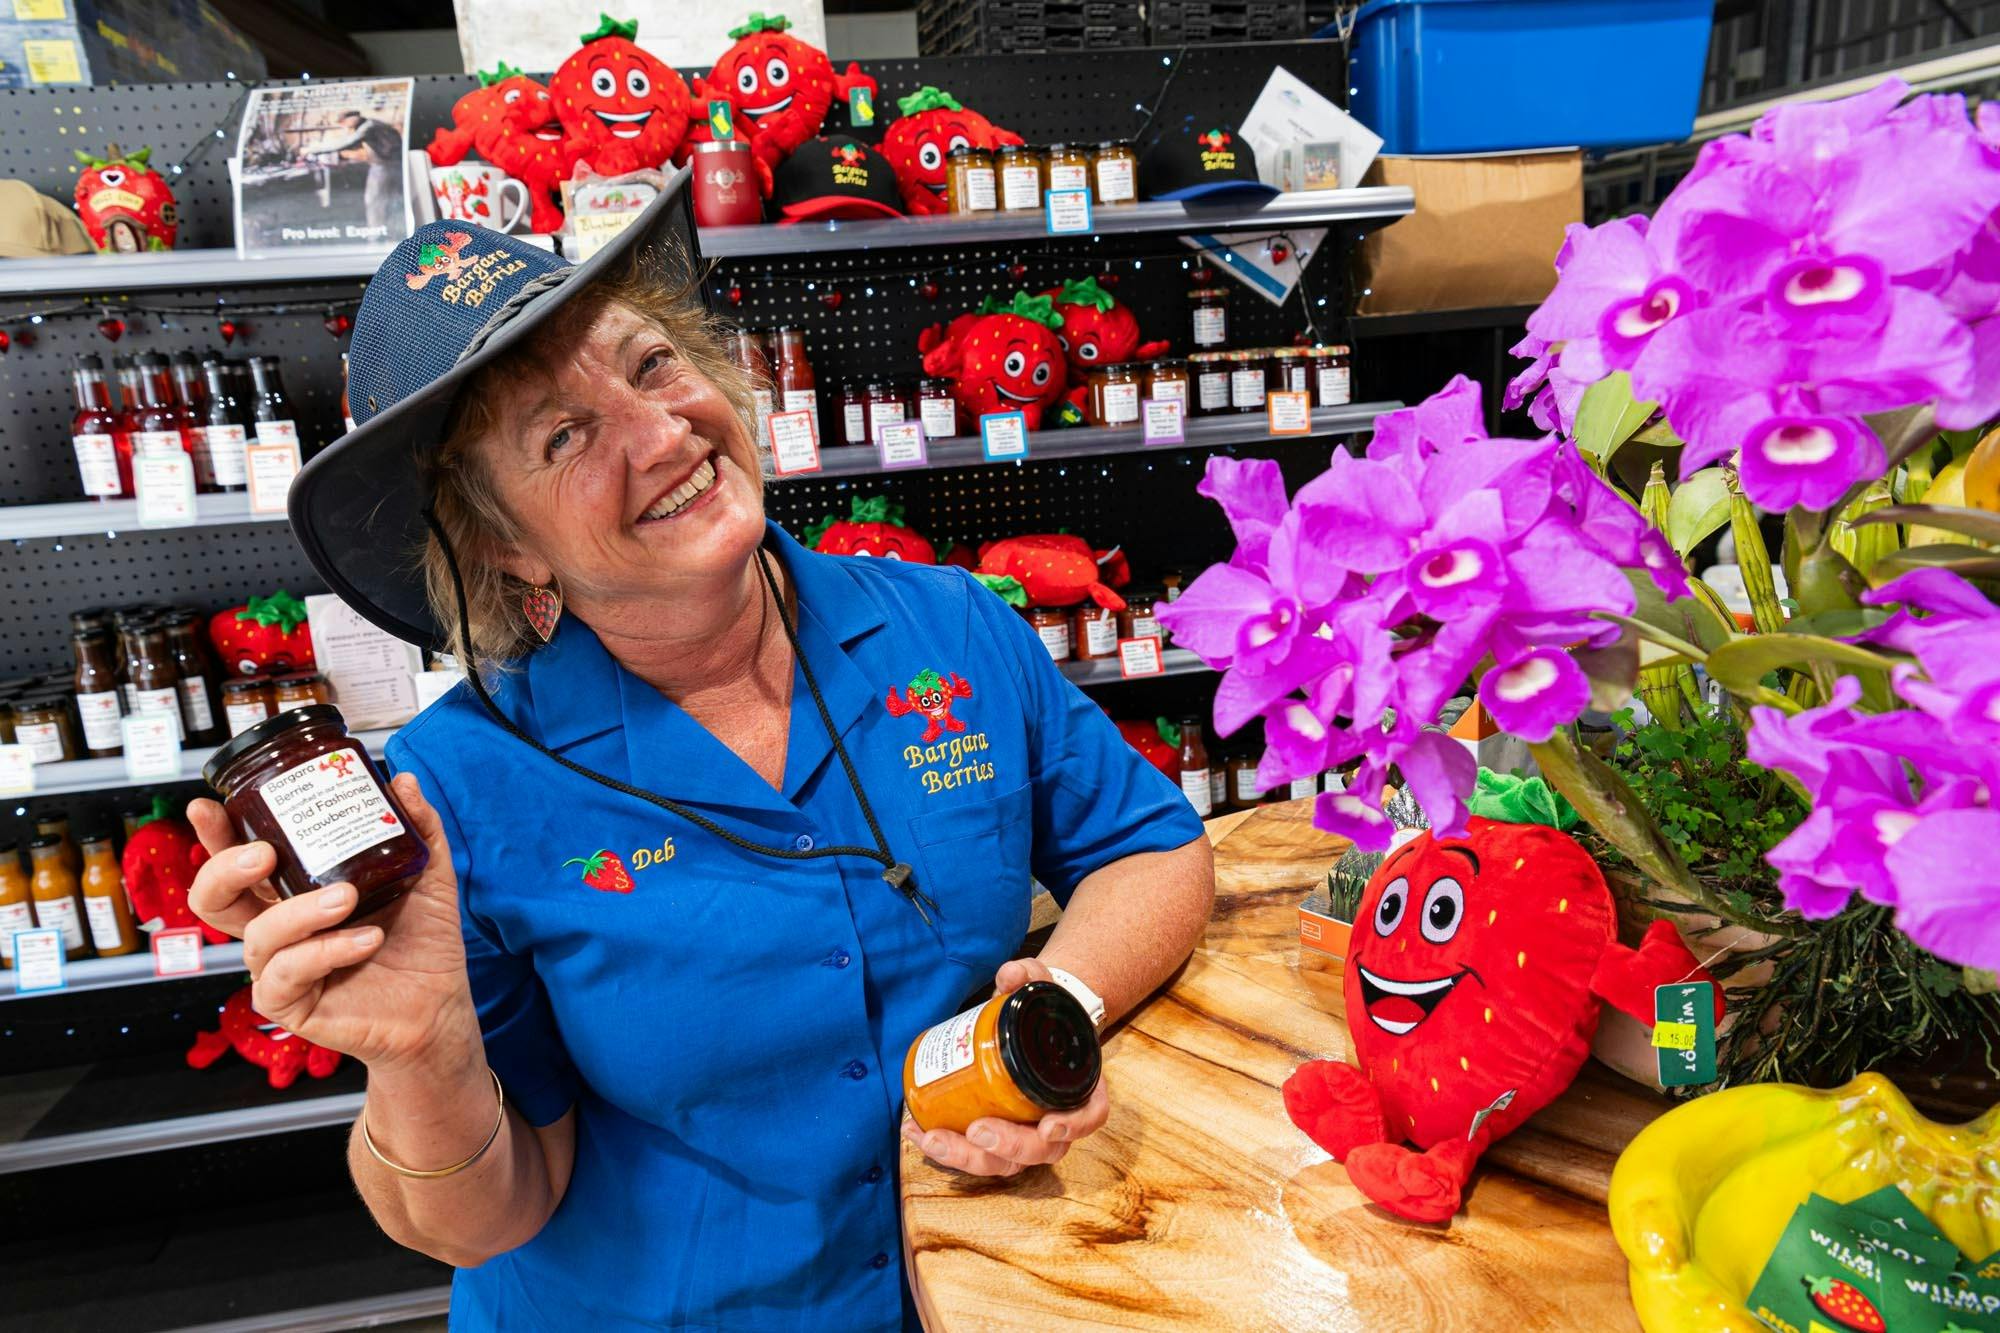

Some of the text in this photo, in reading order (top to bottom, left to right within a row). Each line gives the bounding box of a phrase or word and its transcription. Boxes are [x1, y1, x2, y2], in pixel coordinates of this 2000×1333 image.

[282, 228, 306, 240] Pro
[345, 225, 388, 239] Expert
[442, 250, 511, 304] Bargara
[464, 260, 528, 308] Berries
[903, 732, 989, 769] Bargara
[267, 763, 316, 793] Bargara
[274, 781, 315, 806] Berries
[921, 758, 994, 794] Berries
[292, 783, 372, 824] Old Fashioned
[296, 795, 383, 840] Strawberry Jam
[632, 837, 675, 870] Deb
[1682, 1001, 1697, 1072] WIOT
[1810, 1228, 1877, 1277] WILM
